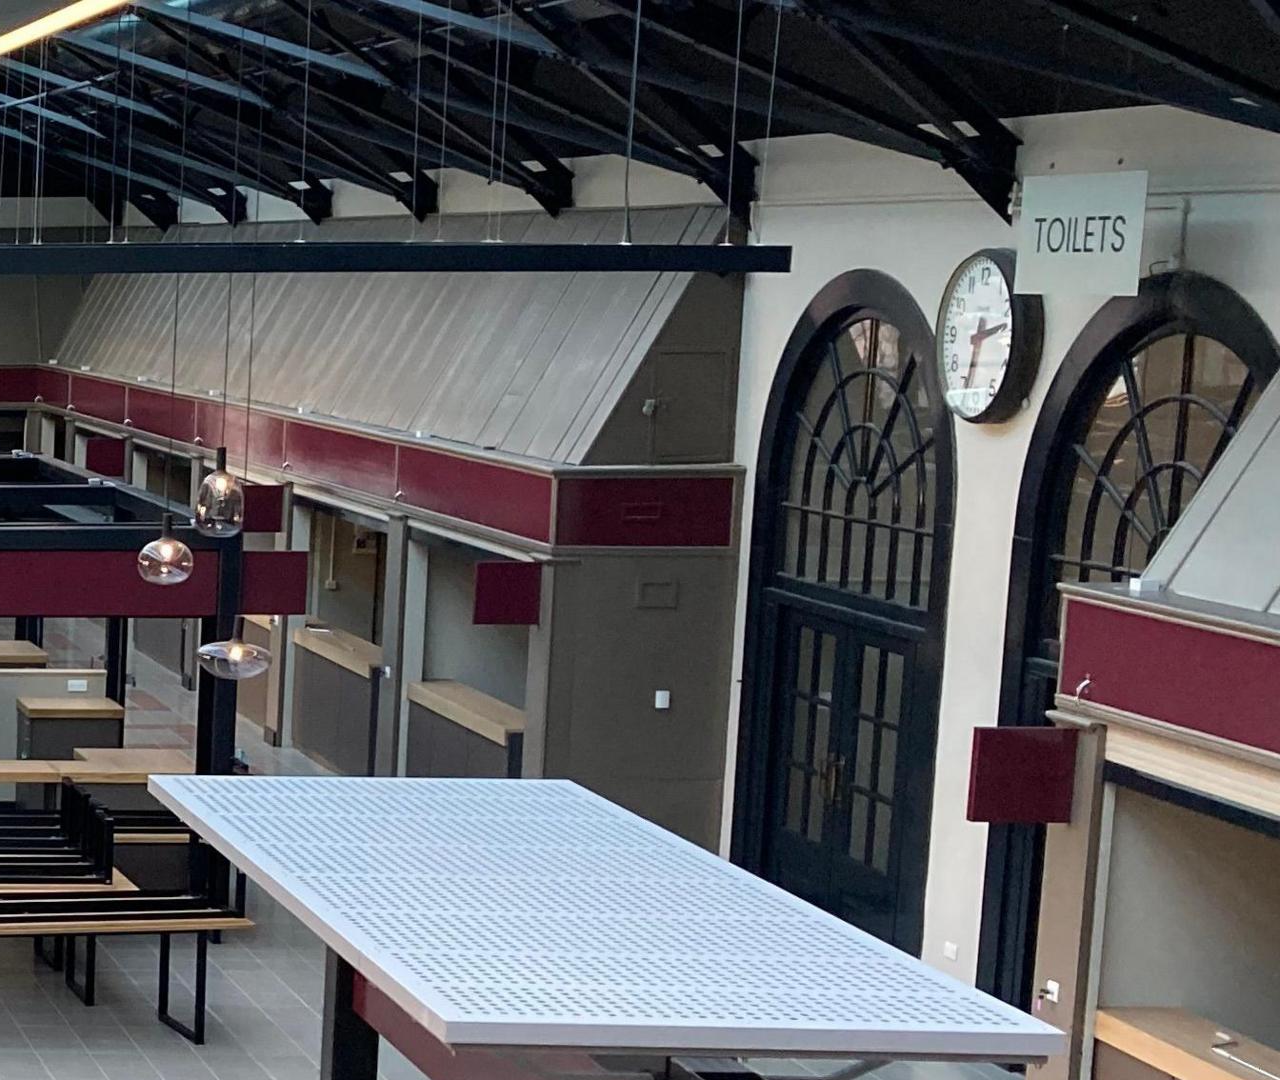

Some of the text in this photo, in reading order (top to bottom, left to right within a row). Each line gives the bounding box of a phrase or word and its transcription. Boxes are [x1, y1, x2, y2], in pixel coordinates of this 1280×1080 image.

[1035, 215, 1126, 253] TOILETS
[968, 275, 976, 295] 11
[981, 266, 992, 287] 12
[956, 296, 966, 314] 10
[950, 325, 957, 344] 9
[951, 353, 959, 372] 8
[988, 378, 996, 397] 5
